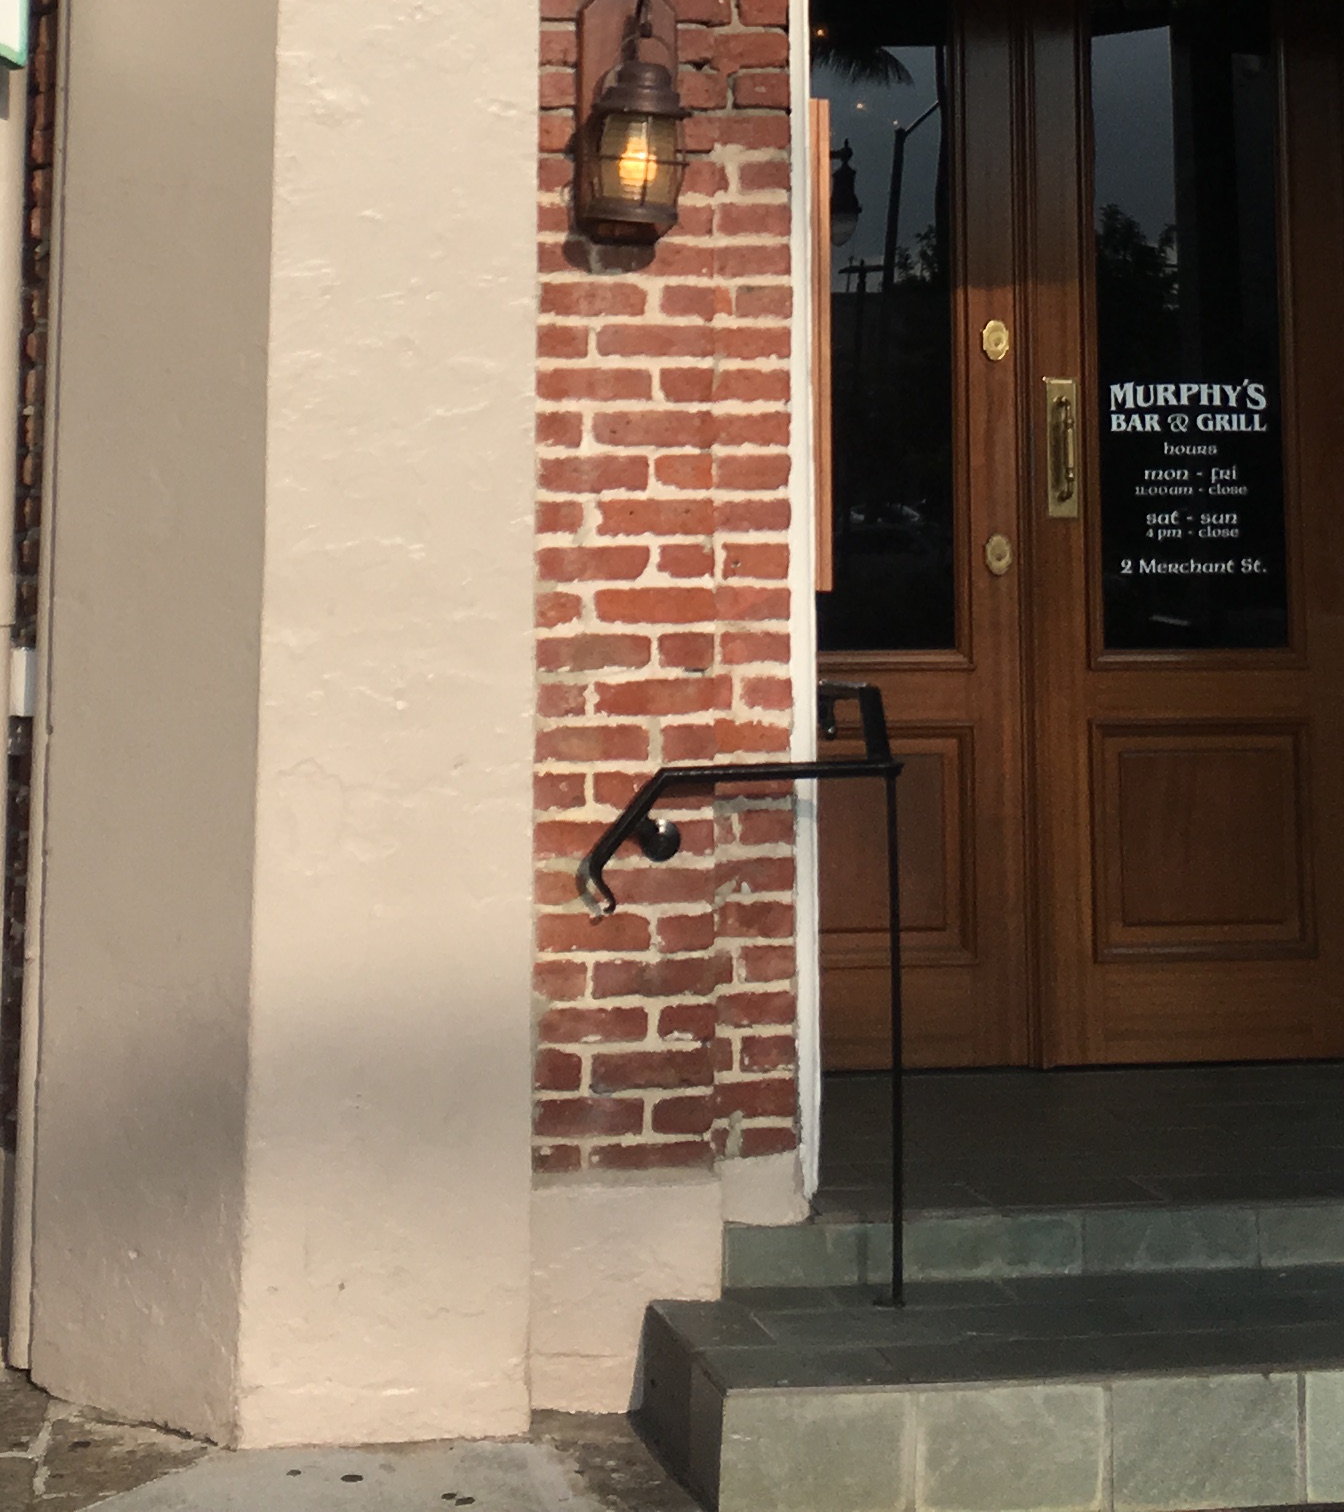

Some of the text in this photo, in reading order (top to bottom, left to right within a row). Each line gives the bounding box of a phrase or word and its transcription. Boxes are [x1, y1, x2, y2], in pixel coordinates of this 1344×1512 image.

[1109, 379, 1268, 412] MURPHY'S
[1110, 413, 1267, 433] BAR & GRILL
[1208, 484, 1248, 496] close
[1198, 525, 1240, 538] close
[1120, 559, 1133, 574] 2
[1139, 559, 1234, 574] Merchant
